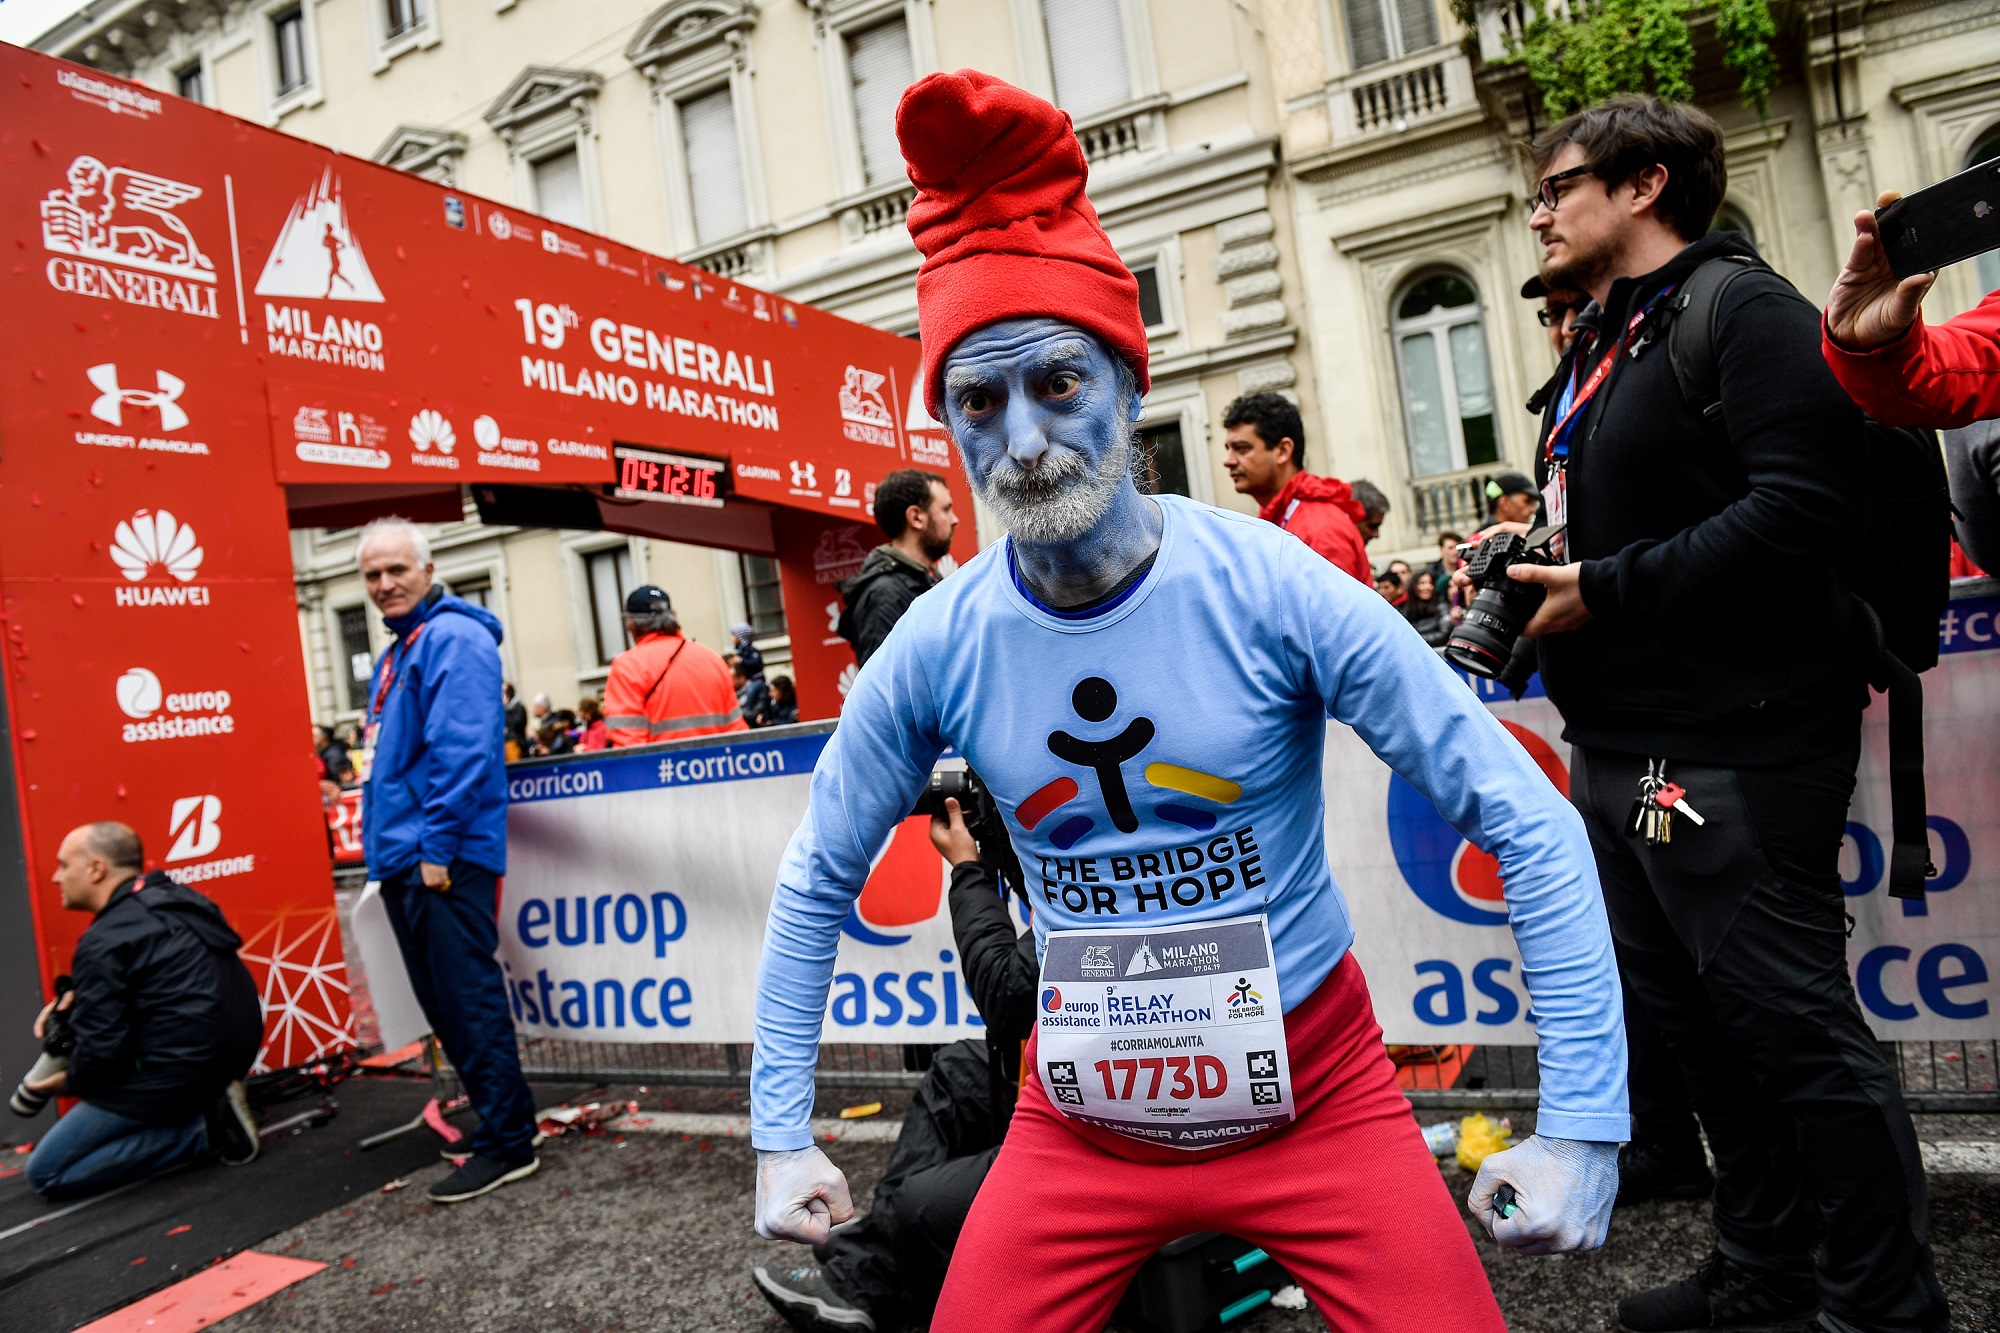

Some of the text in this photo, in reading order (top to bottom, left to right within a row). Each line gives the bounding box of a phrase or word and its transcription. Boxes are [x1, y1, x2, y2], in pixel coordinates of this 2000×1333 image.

[46, 257, 220, 319] GENERALI
[265, 302, 384, 351] MILANO
[268, 334, 385, 371] MARATHON
[514, 298, 774, 397] 19th GENERALI
[521, 355, 779, 432] MILANO MARATHON
[75, 432, 211, 455] UNDER ARMOUR
[843, 421, 896, 448] GENERALI
[909, 433, 949, 457] MILANO
[411, 452, 460, 469] HUAWEI
[547, 438, 608, 460] GARMIN
[621, 458, 715, 500] 04:12:16
[736, 463, 781, 481] GARMIN
[116, 586, 210, 606] HUAWEI
[165, 690, 231, 713] europ
[122, 715, 234, 742] assistance
[510, 747, 785, 799] corricon #corricon
[1034, 825, 1259, 883] THE BRIDGE
[164, 854, 255, 884] DGESTONE
[1041, 854, 1267, 915] FOR HOPE
[517, 891, 687, 958] europ
[1162, 942, 1219, 960] MILANO
[1163, 954, 1220, 969] MARATHON
[1081, 969, 1115, 978] GENERALI
[1193, 963, 1220, 973] 07.04.19
[504, 961, 692, 1028] istance
[1107, 993, 1174, 1012] RELAY
[1065, 1000, 1099, 1014] europ
[1109, 1007, 1212, 1027] MARATHON
[1241, 1005, 1264, 1013] BRIDGE
[1244, 1010, 1265, 1018] HOPE
[1042, 1015, 1100, 1027] assistance
[1110, 1035, 1204, 1051] #CORRIAMOLAVITA
[1094, 1054, 1228, 1100] 1773D
[1105, 1122, 1270, 1140] UNDER ARMOUR
